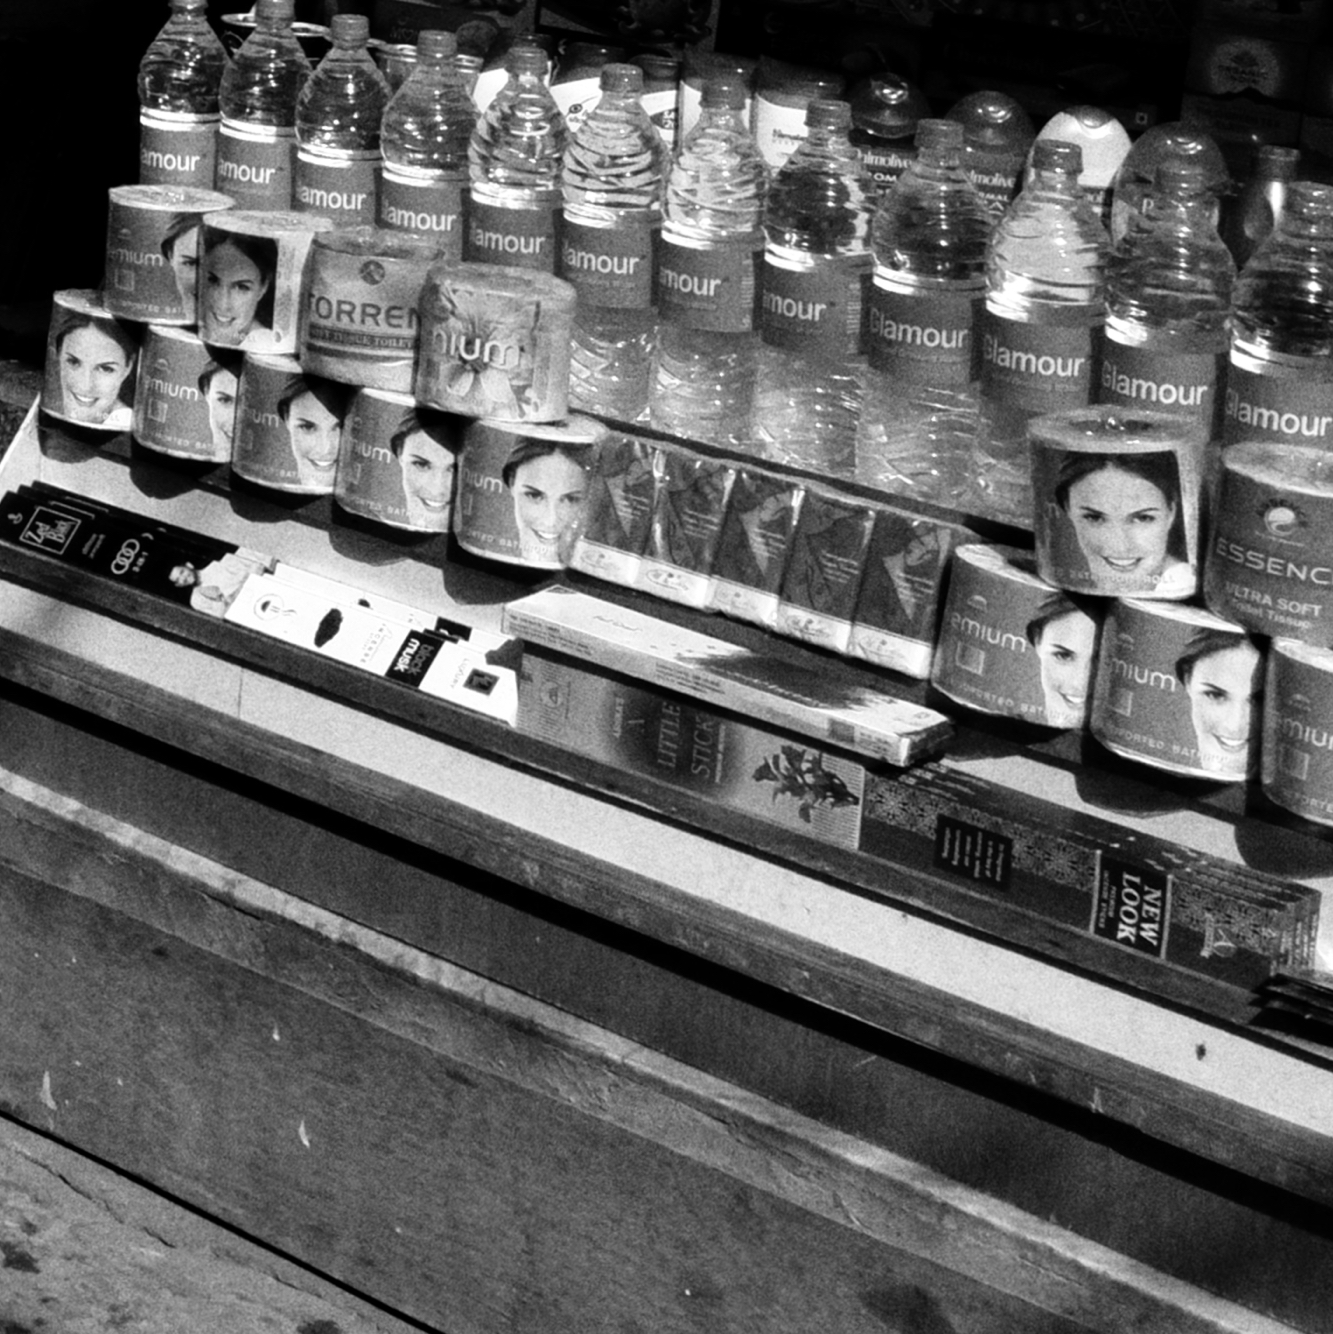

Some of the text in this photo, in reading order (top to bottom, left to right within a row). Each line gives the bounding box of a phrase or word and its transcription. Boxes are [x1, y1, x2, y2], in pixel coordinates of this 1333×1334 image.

[985, 333, 1086, 378] Glamour
[1101, 359, 1209, 407] Glamour
[1225, 384, 1333, 438] Glamour
[1276, 599, 1323, 618] SOFT
[392, 637, 421, 673] musk
[407, 643, 434, 676] black
[656, 700, 682, 768] LITTLE
[1116, 871, 1142, 945] LOOK
[1139, 884, 1162, 947] NEW
